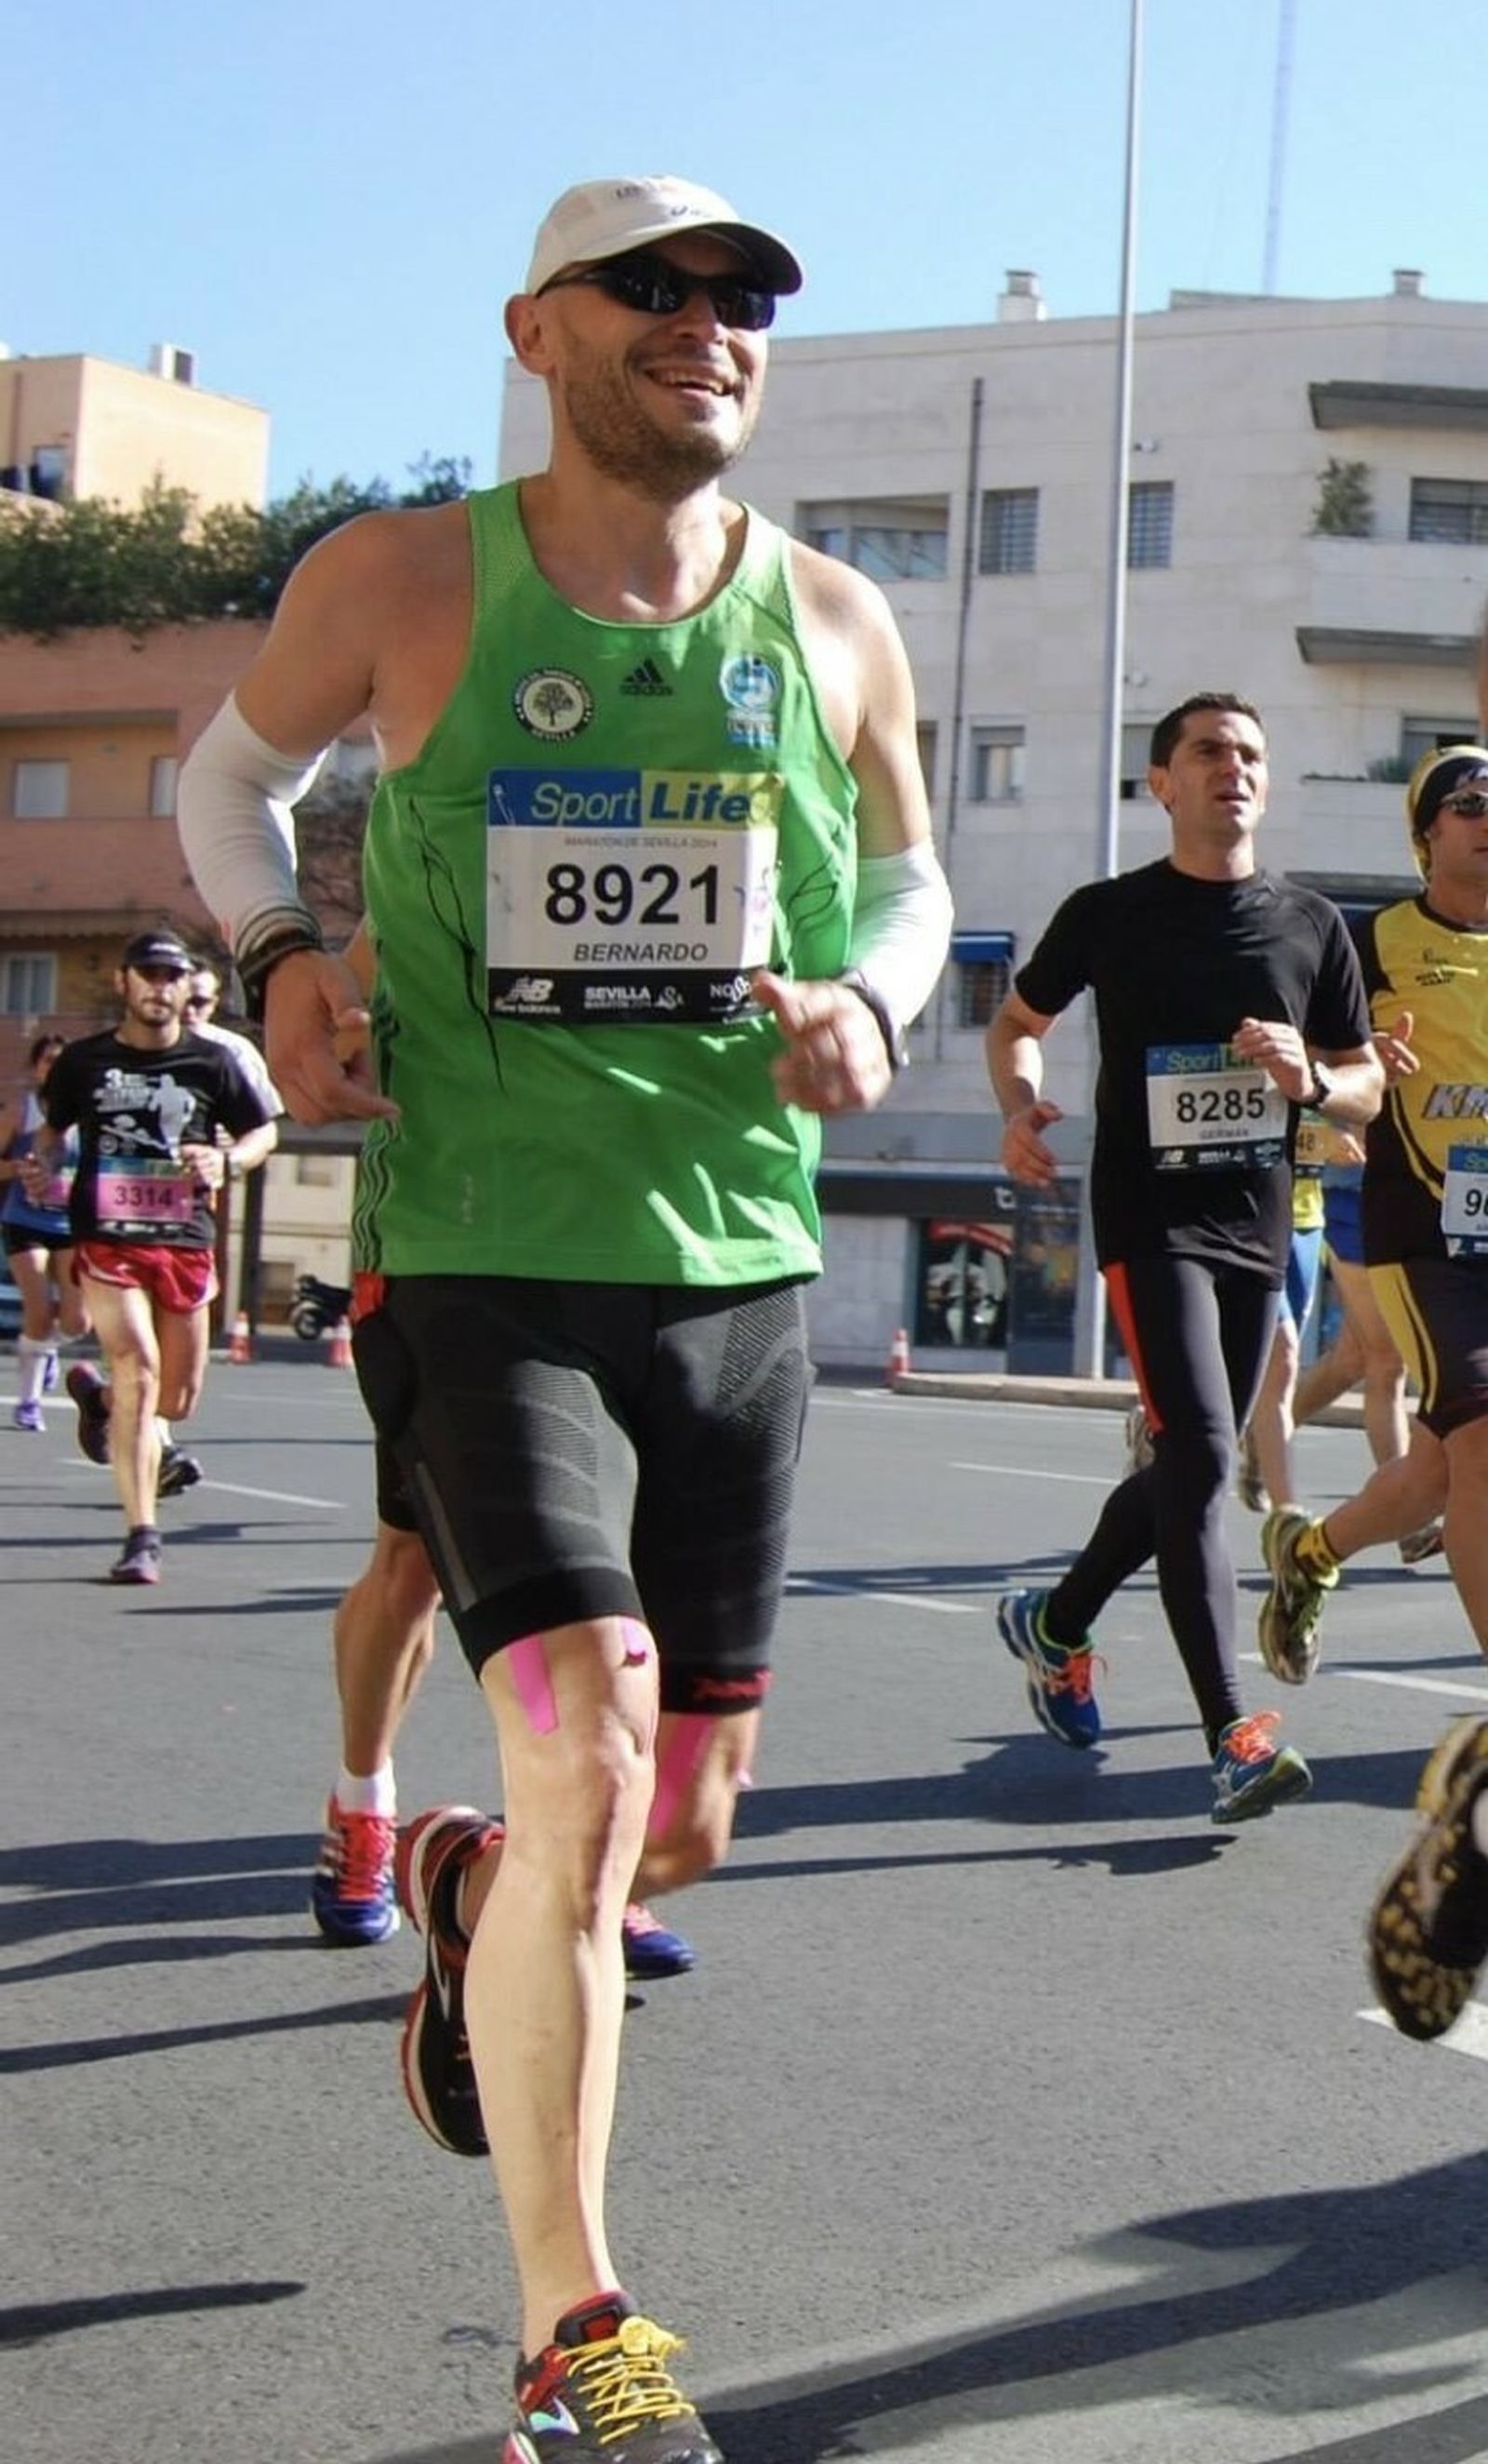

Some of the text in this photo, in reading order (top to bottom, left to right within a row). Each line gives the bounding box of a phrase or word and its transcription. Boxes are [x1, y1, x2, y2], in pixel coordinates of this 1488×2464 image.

[530, 782, 753, 828] Sport Life
[544, 863, 719, 926] 8921
[574, 943, 709, 962] BERNARDO
[584, 986, 651, 1000] SEVILLA
[1165, 1050, 1220, 1076] Sport
[1176, 1087, 1266, 1124] 8285
[114, 1185, 175, 1206] 3314
[1464, 1189, 1488, 1217] 9
